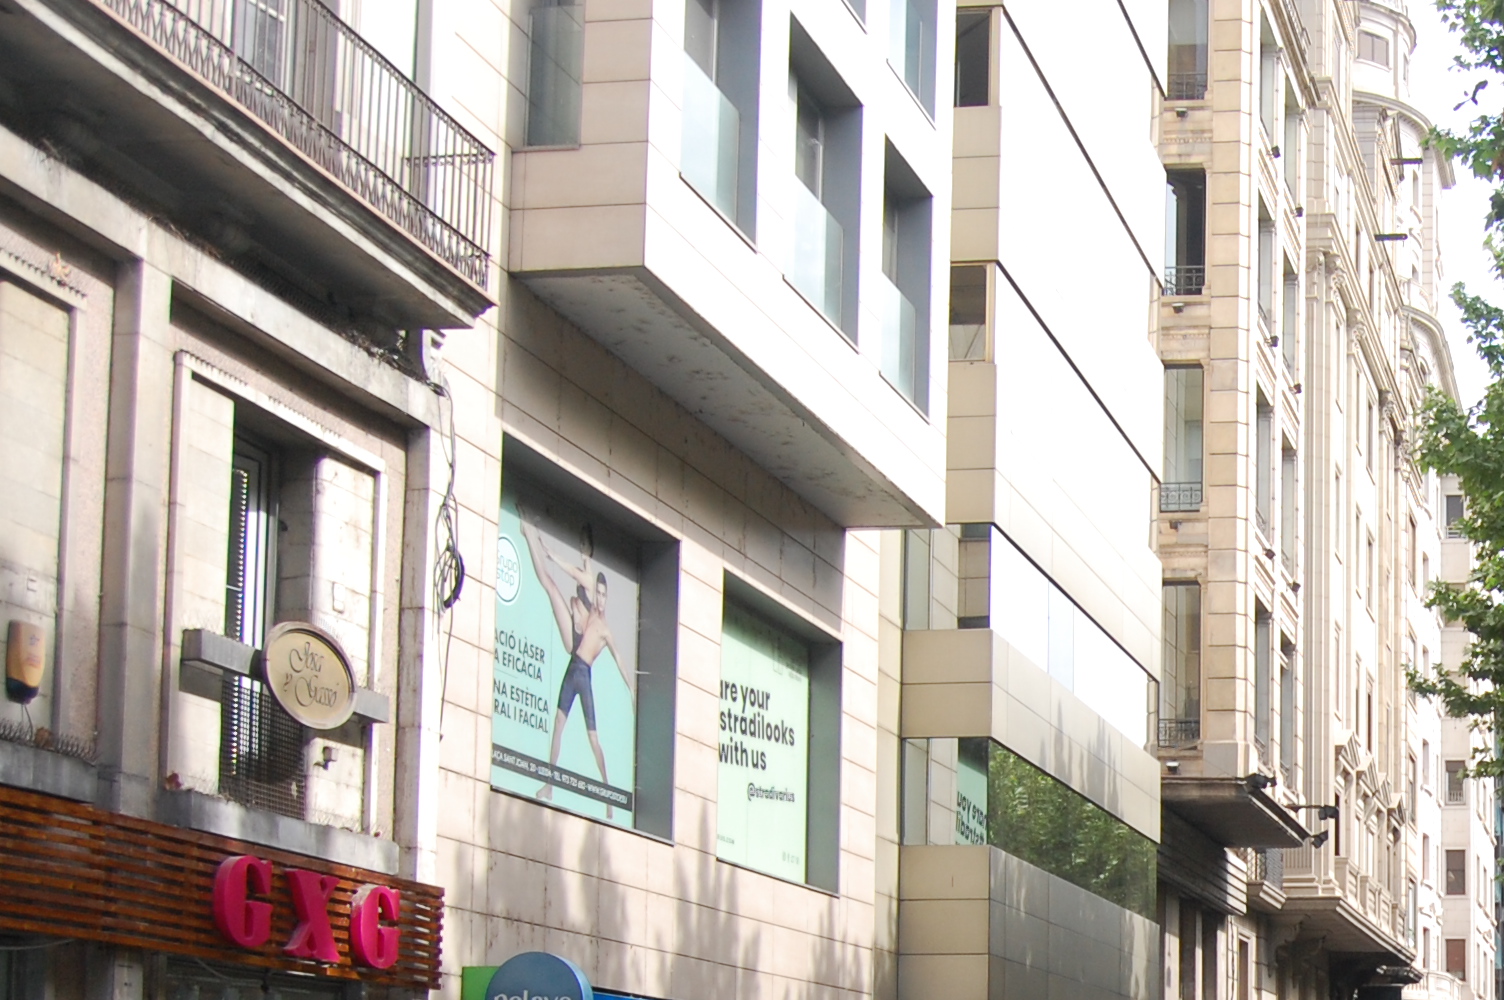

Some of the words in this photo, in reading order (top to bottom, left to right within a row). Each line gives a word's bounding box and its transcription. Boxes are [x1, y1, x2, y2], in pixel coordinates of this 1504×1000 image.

[518, 636, 546, 665] LÀSER
[510, 685, 550, 715] ESTÈTICA
[740, 684, 771, 715] your
[518, 708, 549, 733] FACIAL
[720, 707, 796, 748] stradilooks
[718, 736, 749, 768] with
[751, 749, 767, 772] us
[747, 782, 795, 803] @stradivarius
[212, 855, 401, 970] GXG
